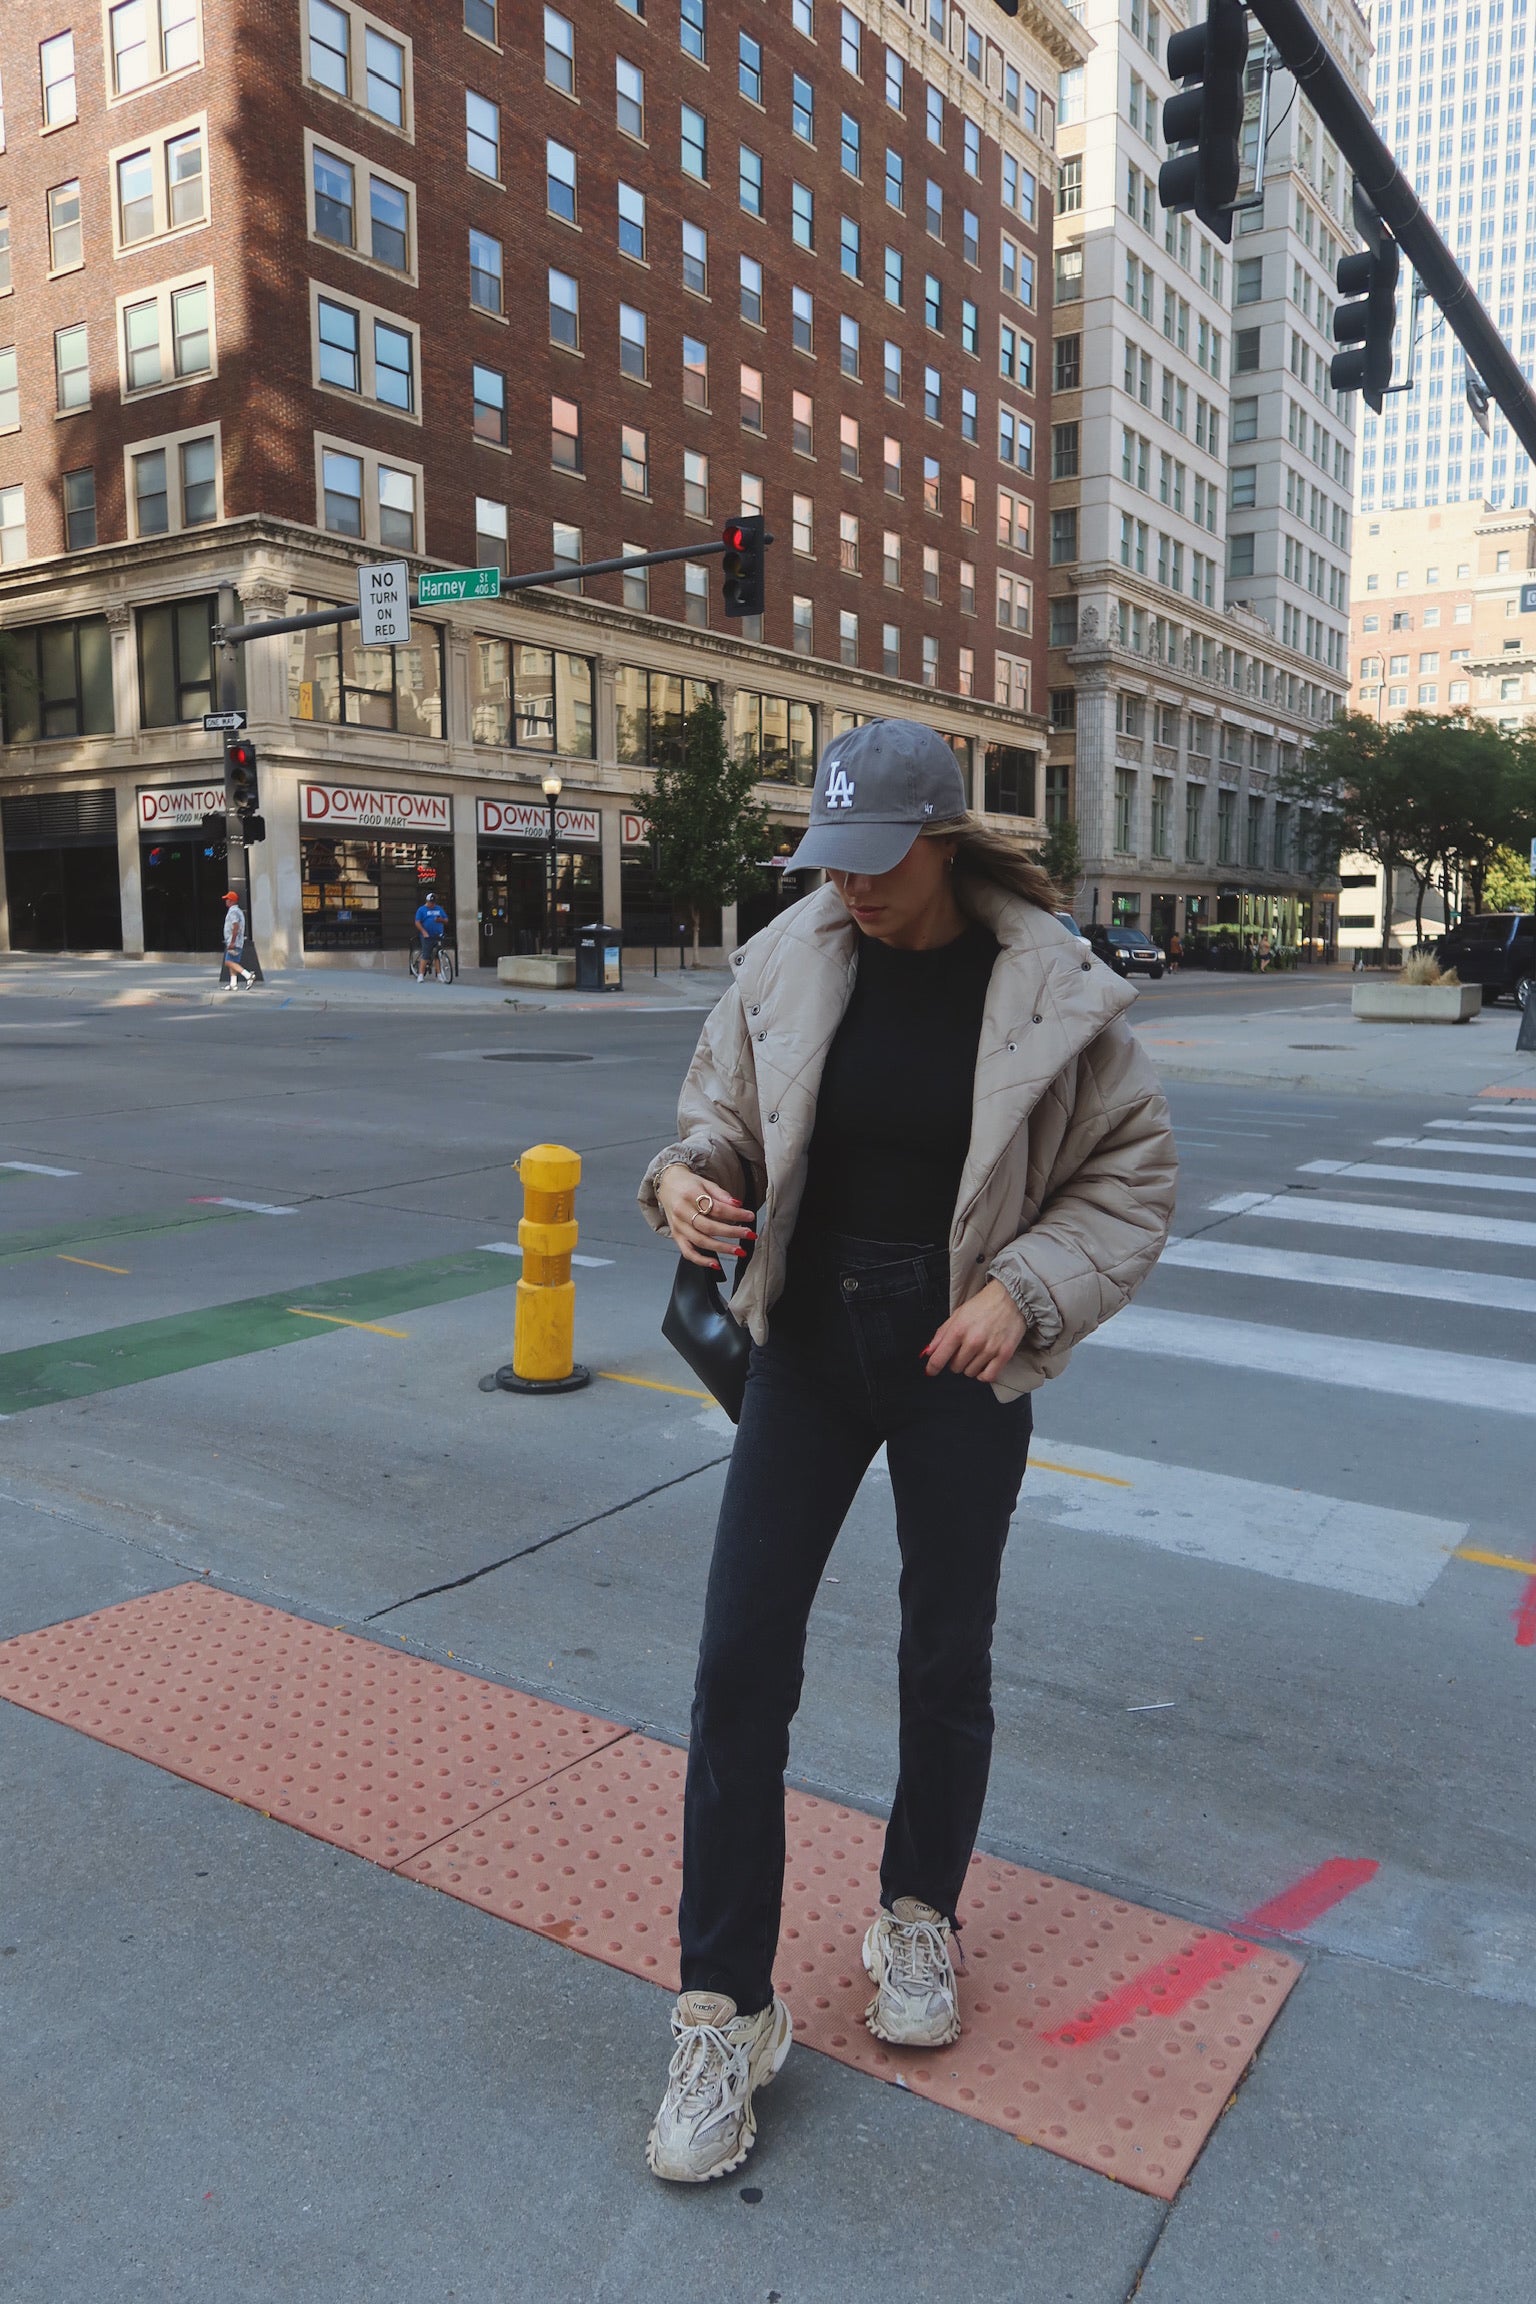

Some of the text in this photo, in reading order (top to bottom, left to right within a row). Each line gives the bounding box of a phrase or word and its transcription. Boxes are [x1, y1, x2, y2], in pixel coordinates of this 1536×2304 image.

[372, 572, 394, 588] NO
[421, 572, 488, 598] Harney St
[474, 583, 496, 595] 400 S
[370, 591, 398, 605] TURN
[377, 609, 392, 620] ON
[375, 624, 396, 636] RED
[207, 717, 235, 726] ONE WAY
[825, 760, 855, 809] LA
[142, 791, 227, 822] DOWNTOW
[306, 786, 446, 819] DOWNTOWN
[176, 812, 192, 822] FOOD
[358, 814, 408, 828] FOOD MART
[483, 802, 596, 832] DOWNOWN
[524, 826, 543, 837] FOOD
